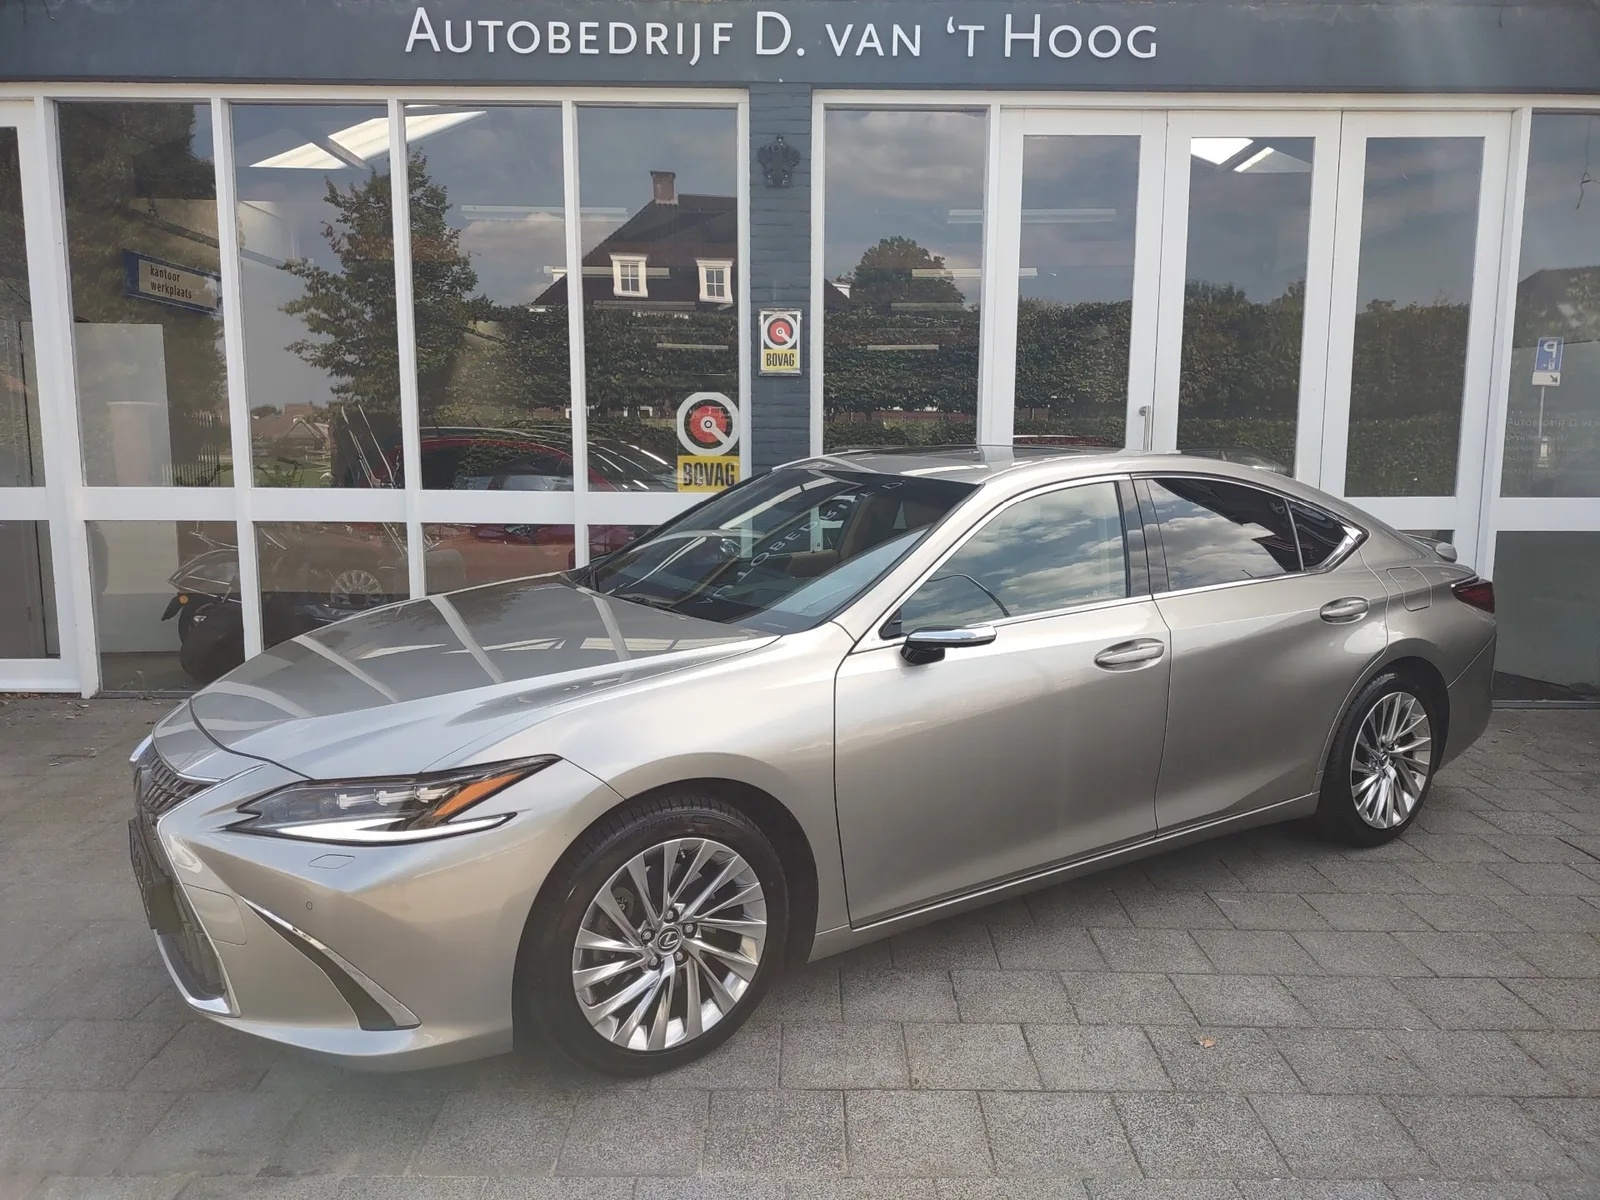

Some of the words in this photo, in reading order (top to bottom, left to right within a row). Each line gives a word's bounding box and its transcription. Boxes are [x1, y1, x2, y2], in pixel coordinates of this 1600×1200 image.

[405, 6, 733, 66] AUTOBEDRIJF
[756, 11, 805, 55] D.
[825, 23, 921, 57] VAN
[1004, 13, 1157, 59] HOOG
[150, 264, 180, 282] kantoor
[150, 280, 192, 299] werkplaats
[766, 352, 795, 367] BOVAG
[682, 461, 735, 487] BOVAG
